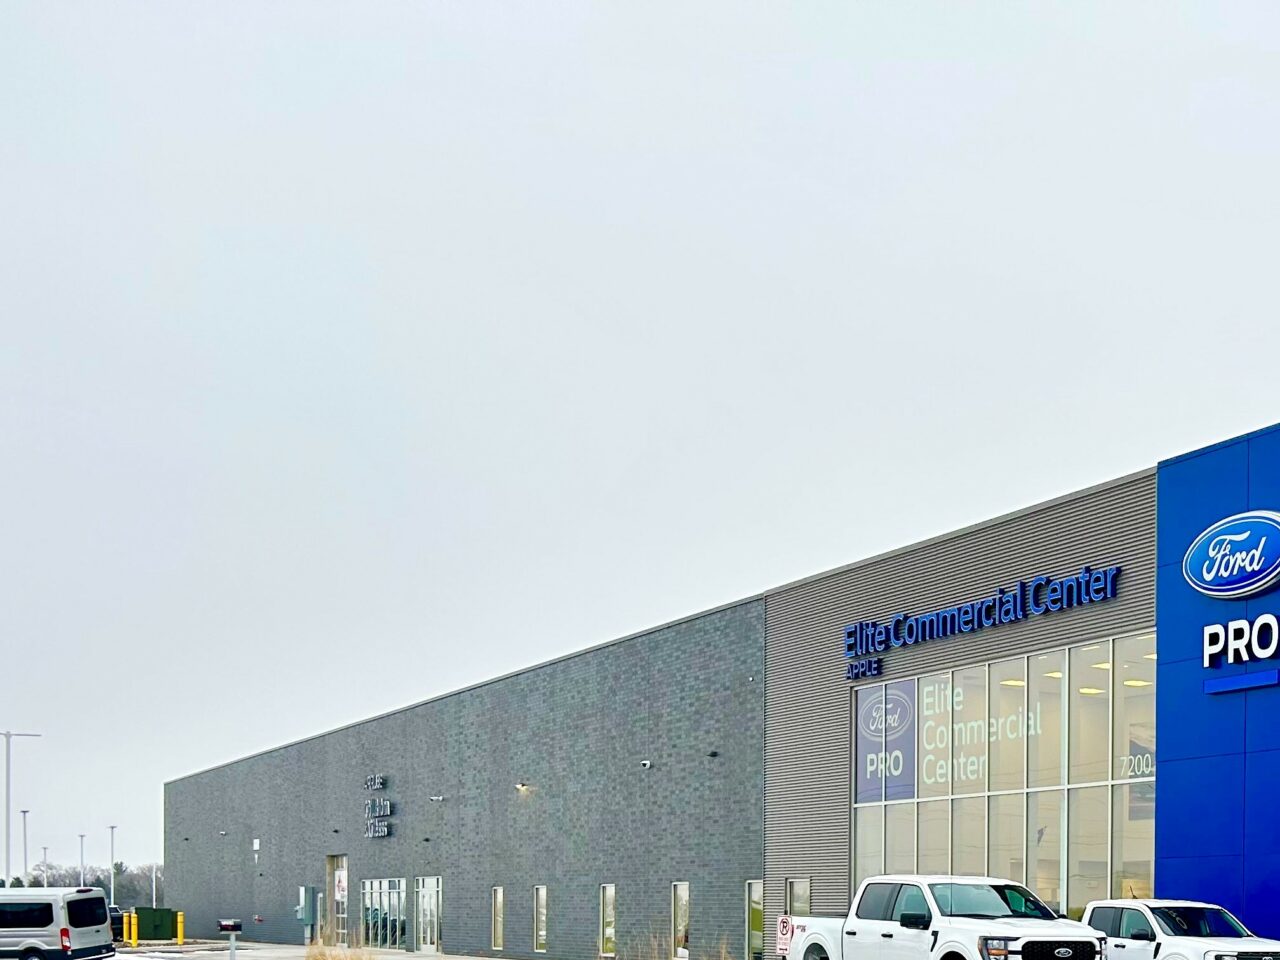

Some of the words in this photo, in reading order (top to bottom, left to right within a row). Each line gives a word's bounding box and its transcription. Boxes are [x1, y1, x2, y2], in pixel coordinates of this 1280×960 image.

[1202, 530, 1268, 582] Ford
[843, 620, 886, 657] Elite
[890, 581, 1025, 647] Commercial
[1029, 566, 1120, 615] Center
[1203, 613, 1279, 668] PRO
[845, 657, 879, 679] APPLE
[923, 683, 964, 716] Elite
[869, 702, 901, 731] Ford
[922, 702, 1042, 750] Commercial
[866, 750, 904, 779] PRO
[922, 752, 986, 785] Center
[1120, 753, 1152, 777] 7200
